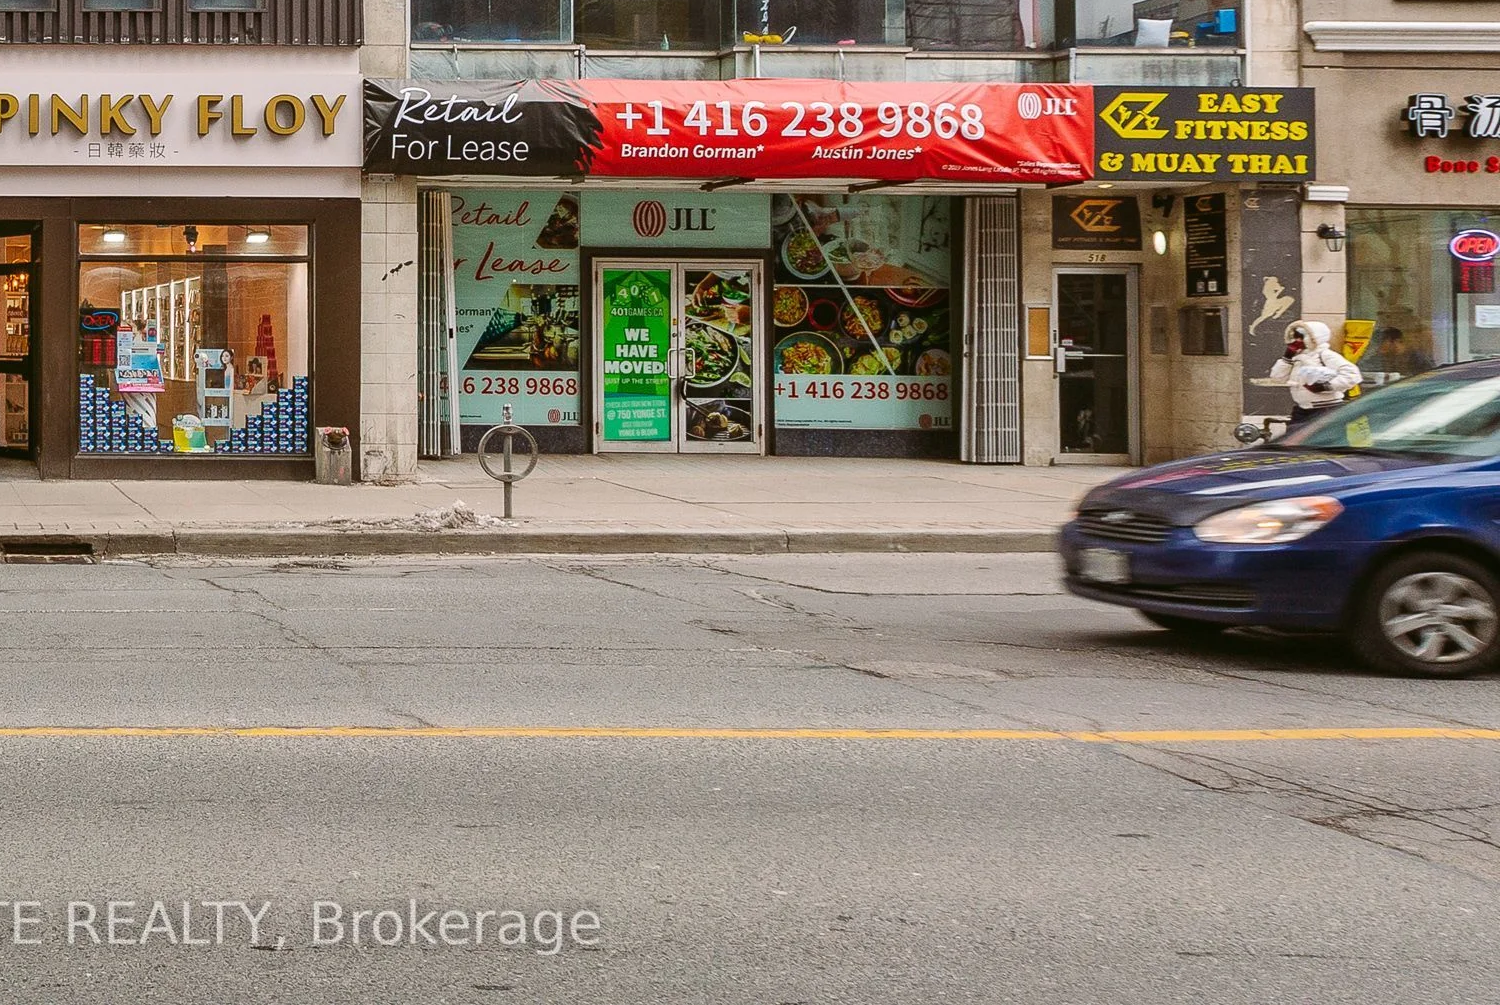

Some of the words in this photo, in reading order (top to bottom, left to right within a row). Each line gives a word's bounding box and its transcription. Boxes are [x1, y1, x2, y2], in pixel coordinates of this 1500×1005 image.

[394, 87, 523, 129] Retail
[1042, 98, 1077, 116] JLL
[1198, 94, 1284, 114] EASY
[197, 93, 348, 136] FLOY
[616, 100, 670, 136] +1
[683, 100, 768, 137] 416
[780, 100, 864, 138] 238
[877, 102, 986, 140] 9868
[1175, 120, 1308, 141] FITNESS
[391, 134, 438, 160] For
[447, 135, 529, 162] Lease
[621, 144, 689, 158] Brandon
[812, 146, 864, 160] Austin
[1099, 153, 1124, 173] &
[1131, 153, 1222, 174] MUAY
[1227, 154, 1308, 174] THAI
[1425, 155, 1480, 173] Bone
[669, 207, 715, 232] JLL
[1456, 238, 1498, 254] OPEN
[475, 241, 570, 281] Lease
[83, 315, 115, 326] OPEN
[624, 328, 650, 341] WE
[616, 345, 658, 358] HAVE
[604, 360, 668, 374] MOVED!
[481, 377, 519, 394] 238
[526, 378, 577, 395] 9868
[775, 382, 798, 398] +1
[806, 382, 844, 399] 416
[851, 382, 889, 399] 238
[896, 383, 948, 400] 9868
